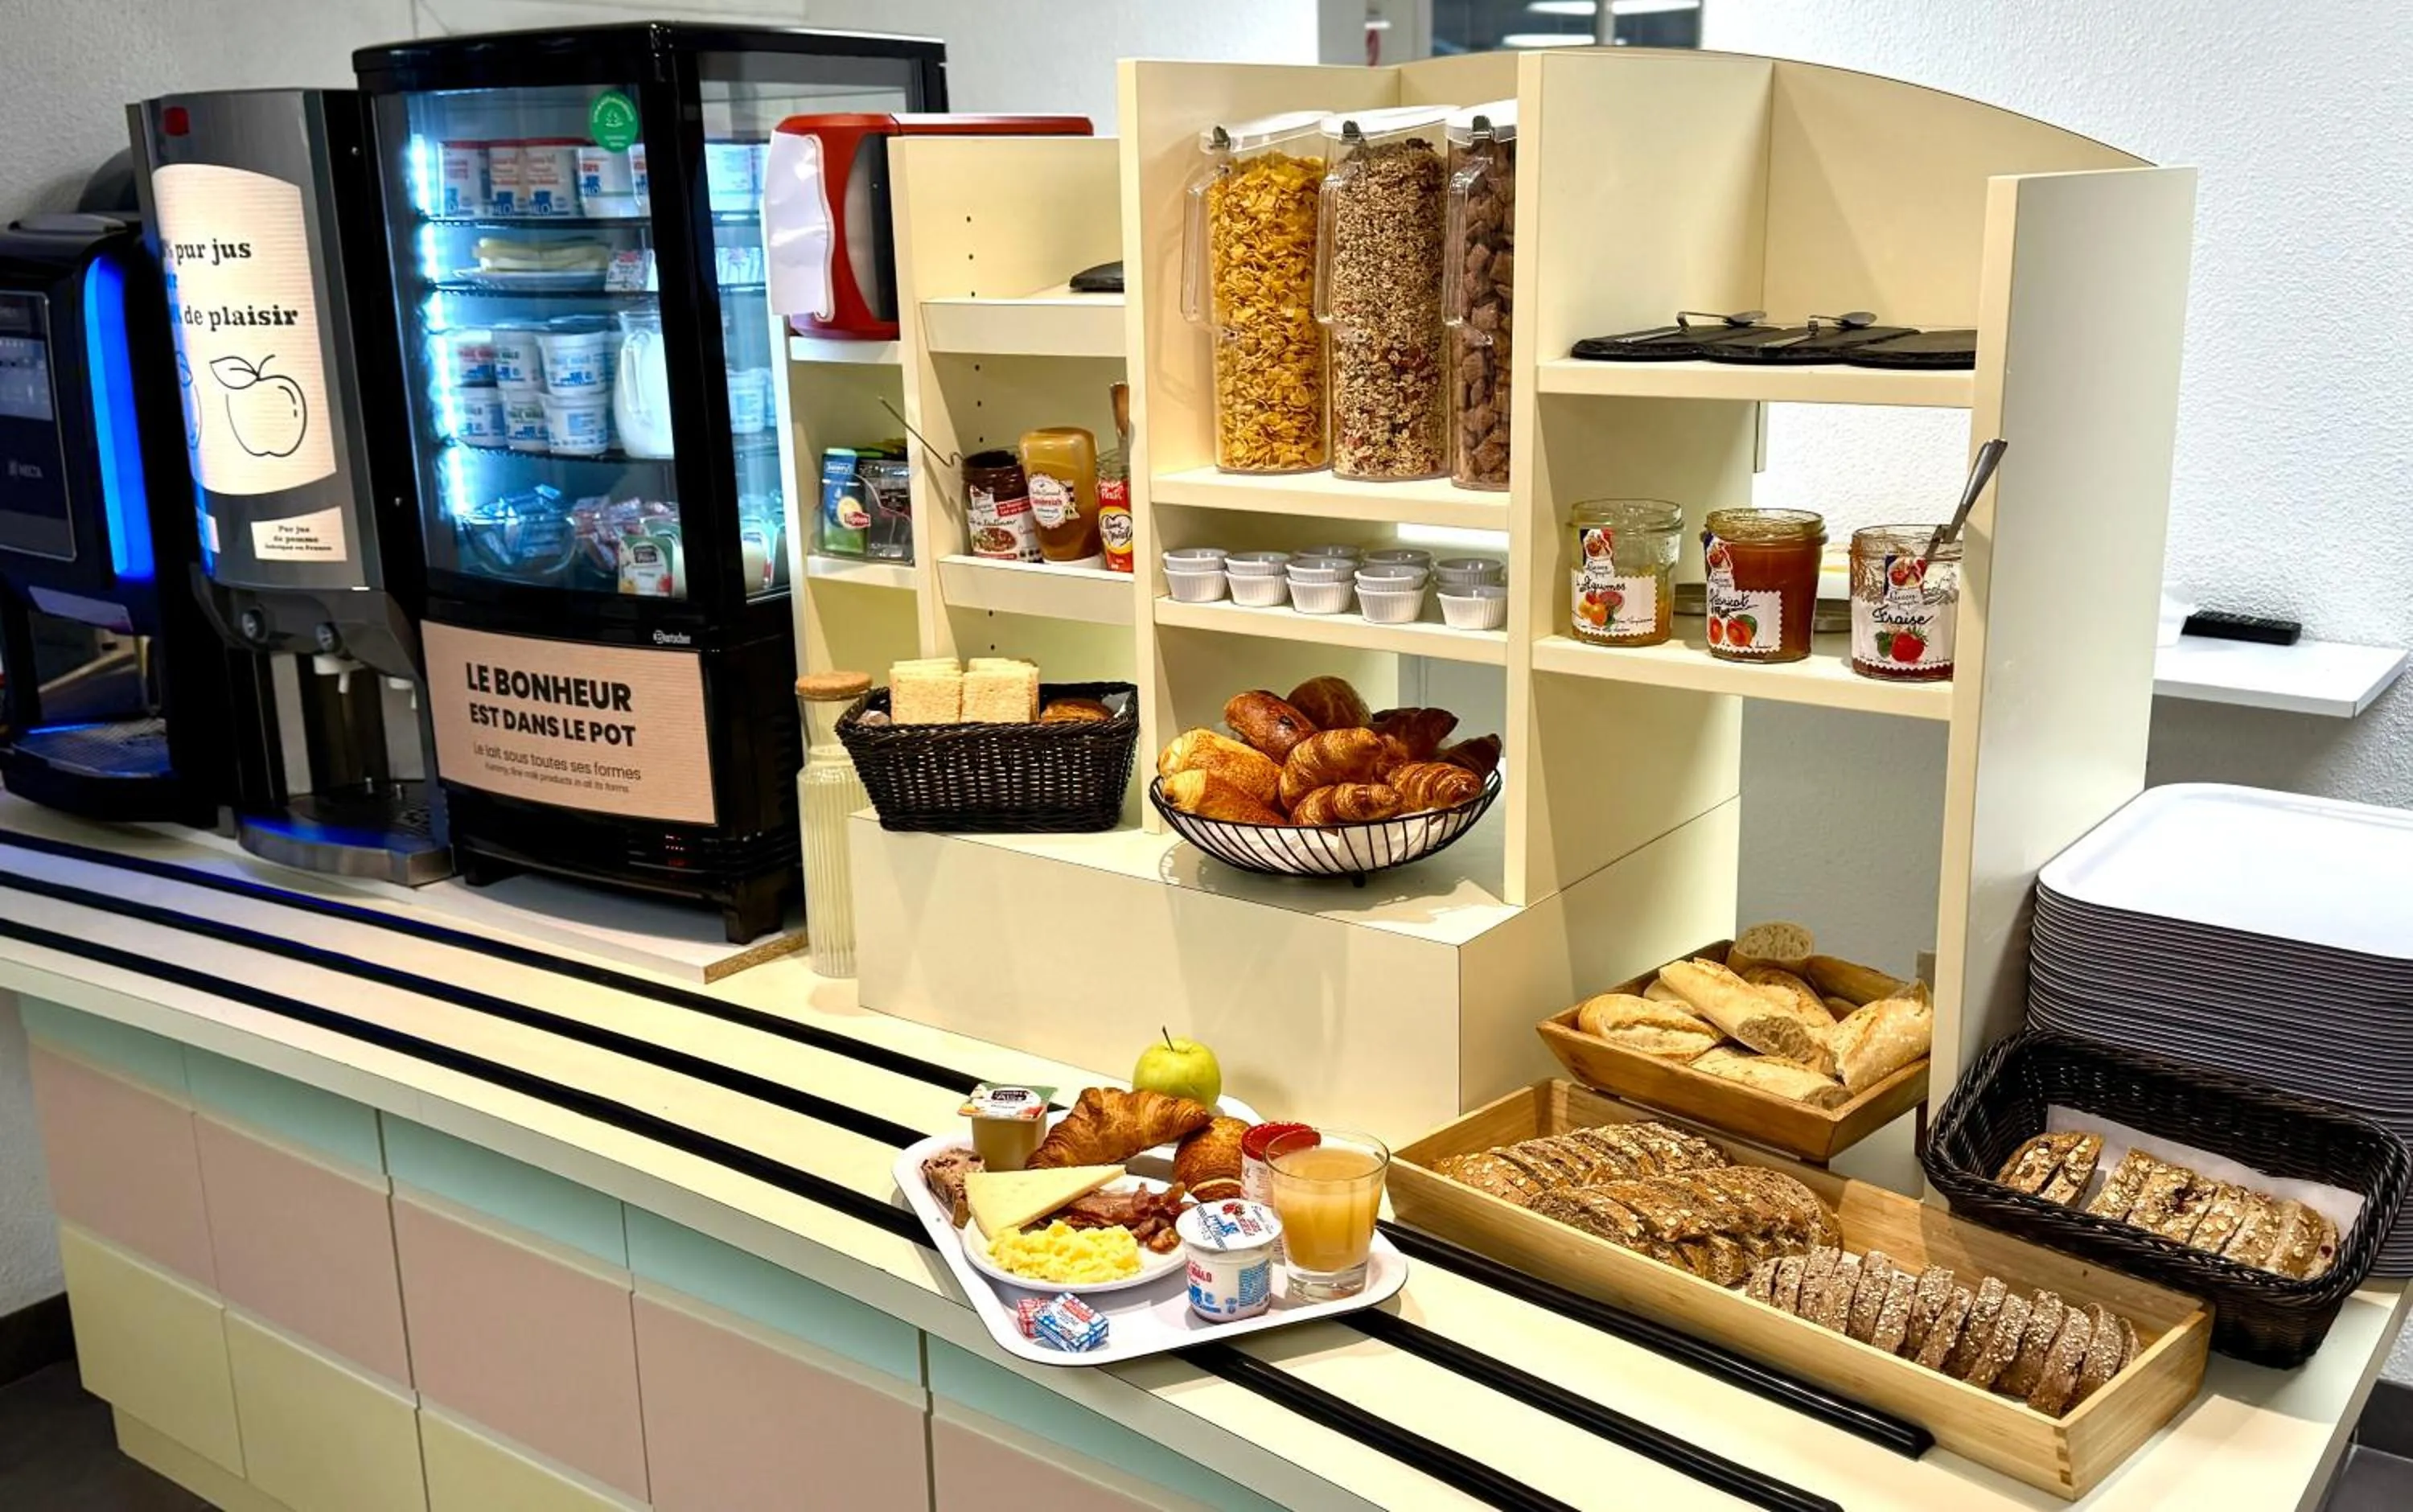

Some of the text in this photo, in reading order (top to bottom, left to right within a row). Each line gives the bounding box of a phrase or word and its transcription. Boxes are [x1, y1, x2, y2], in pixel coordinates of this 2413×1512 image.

[175, 244, 206, 266] pur
[212, 238, 252, 266] jus
[184, 305, 203, 326] de
[208, 304, 298, 332] plaisir
[1872, 604, 1934, 625] Fraise
[466, 662, 632, 713] LE BONHEUR
[470, 702, 636, 747] EST DANS LE POT
[473, 742, 641, 781] Le lait sous toutes ses formes
